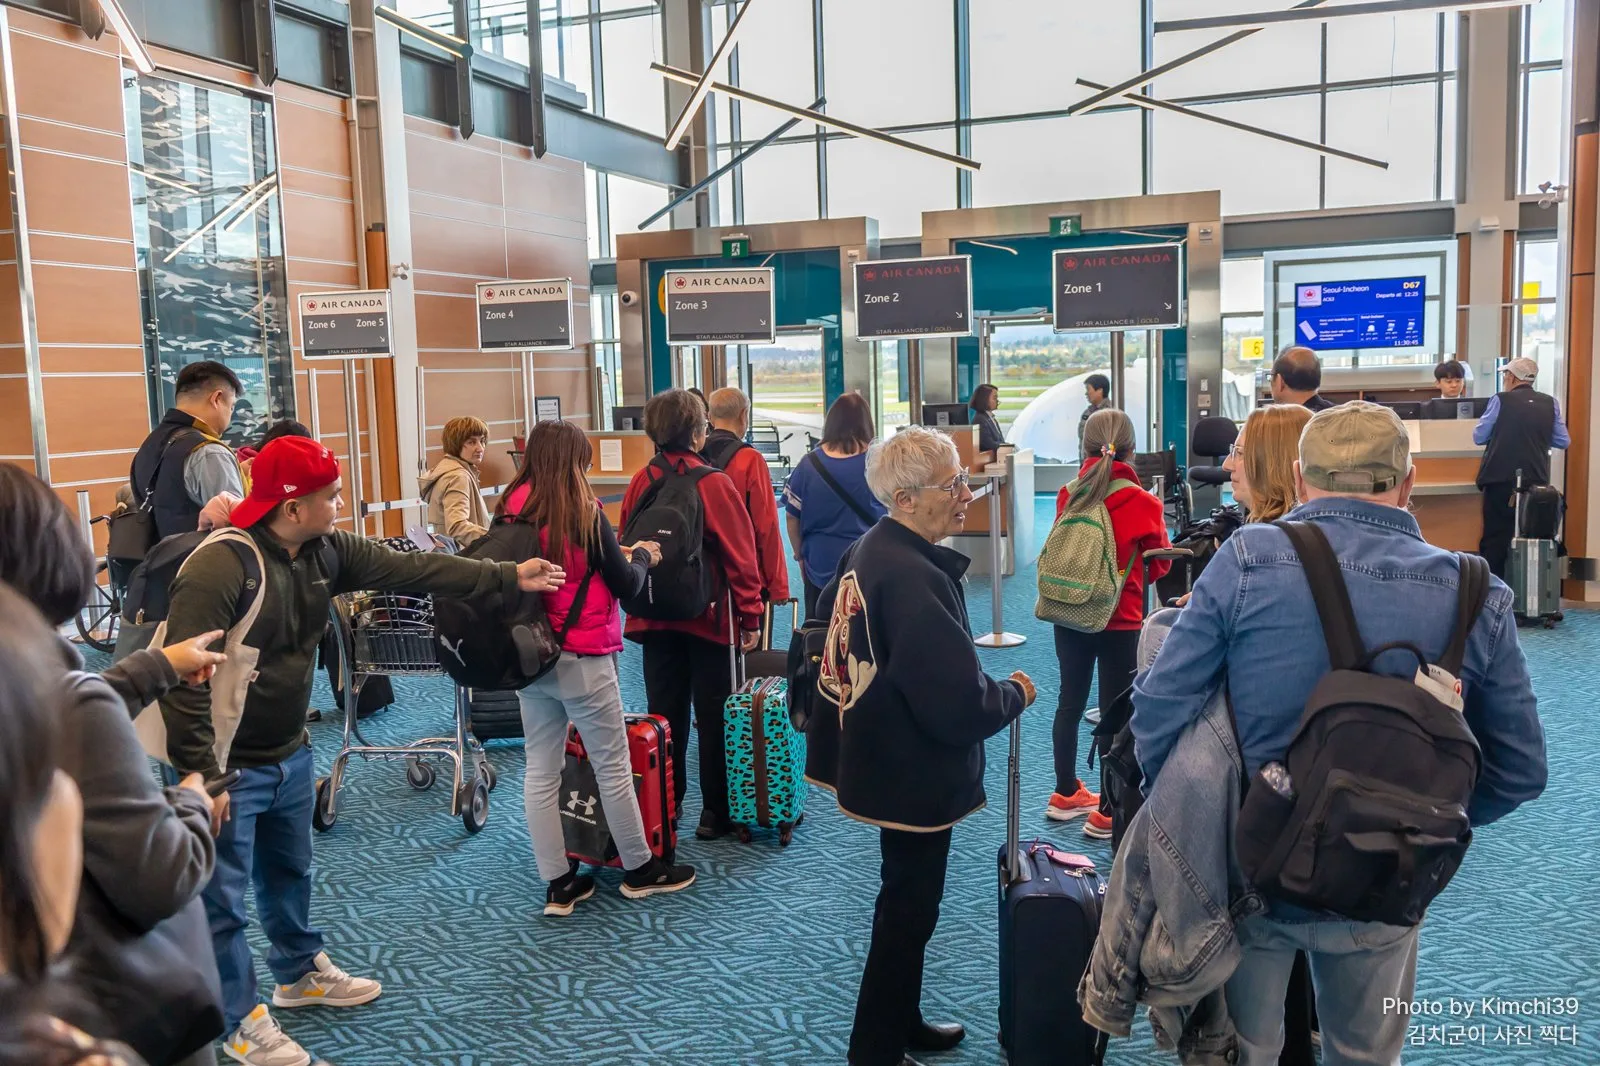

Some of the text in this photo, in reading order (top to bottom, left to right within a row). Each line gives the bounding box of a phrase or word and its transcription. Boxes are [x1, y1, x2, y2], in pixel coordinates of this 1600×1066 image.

[1083, 254, 1172, 267] AIR CANADA
[882, 264, 960, 278] AIR CANADA
[714, 277, 765, 286] CANADA
[518, 287, 563, 296] CANADA
[1064, 282, 1102, 294] Zone 1
[1322, 281, 1420, 294] Seoul-Incheon D67
[864, 292, 899, 304] Zone 2
[340, 299, 382, 308] CANADA
[675, 300, 708, 310] Zone 3
[486, 310, 514, 320] Zone 4
[308, 320, 336, 329] Zone 6
[356, 318, 384, 327] Zone 5
